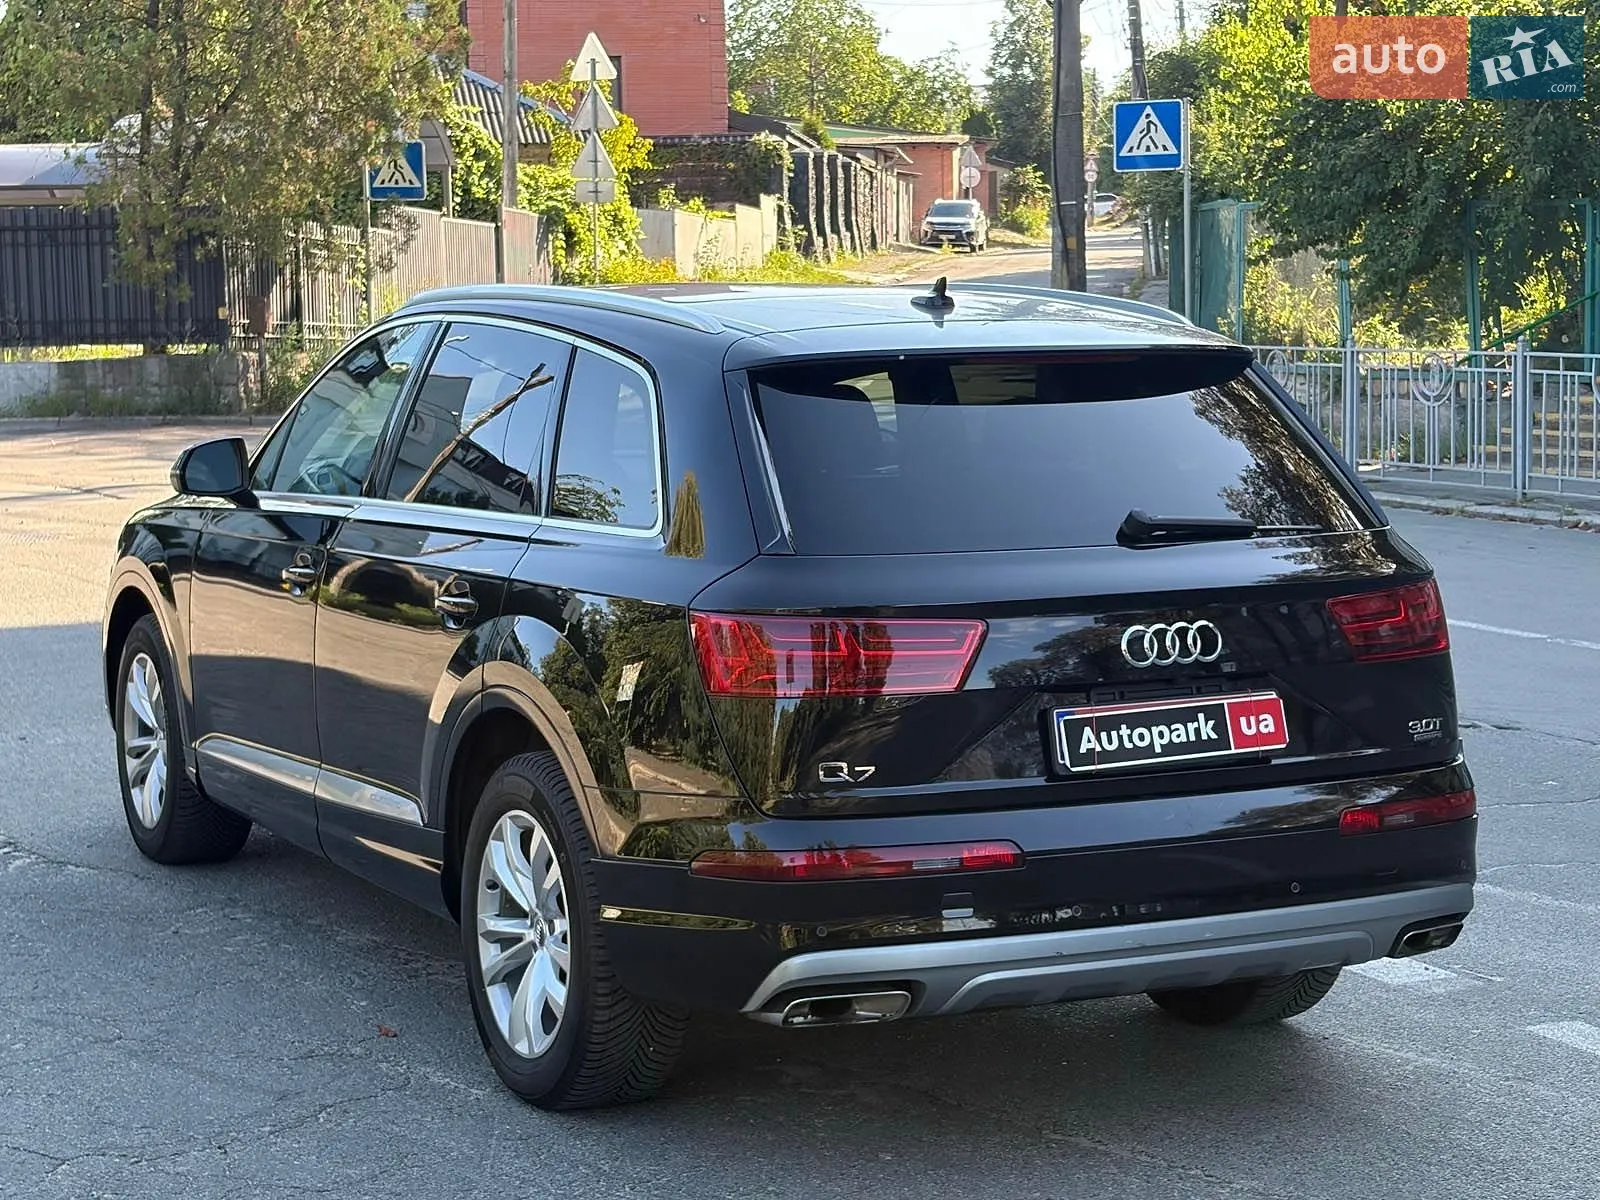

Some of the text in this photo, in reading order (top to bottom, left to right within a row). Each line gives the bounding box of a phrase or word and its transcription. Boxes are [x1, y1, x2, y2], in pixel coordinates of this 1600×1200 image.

[1079, 713, 1276, 753] Autopark ua
[818, 761, 876, 782] Q7
